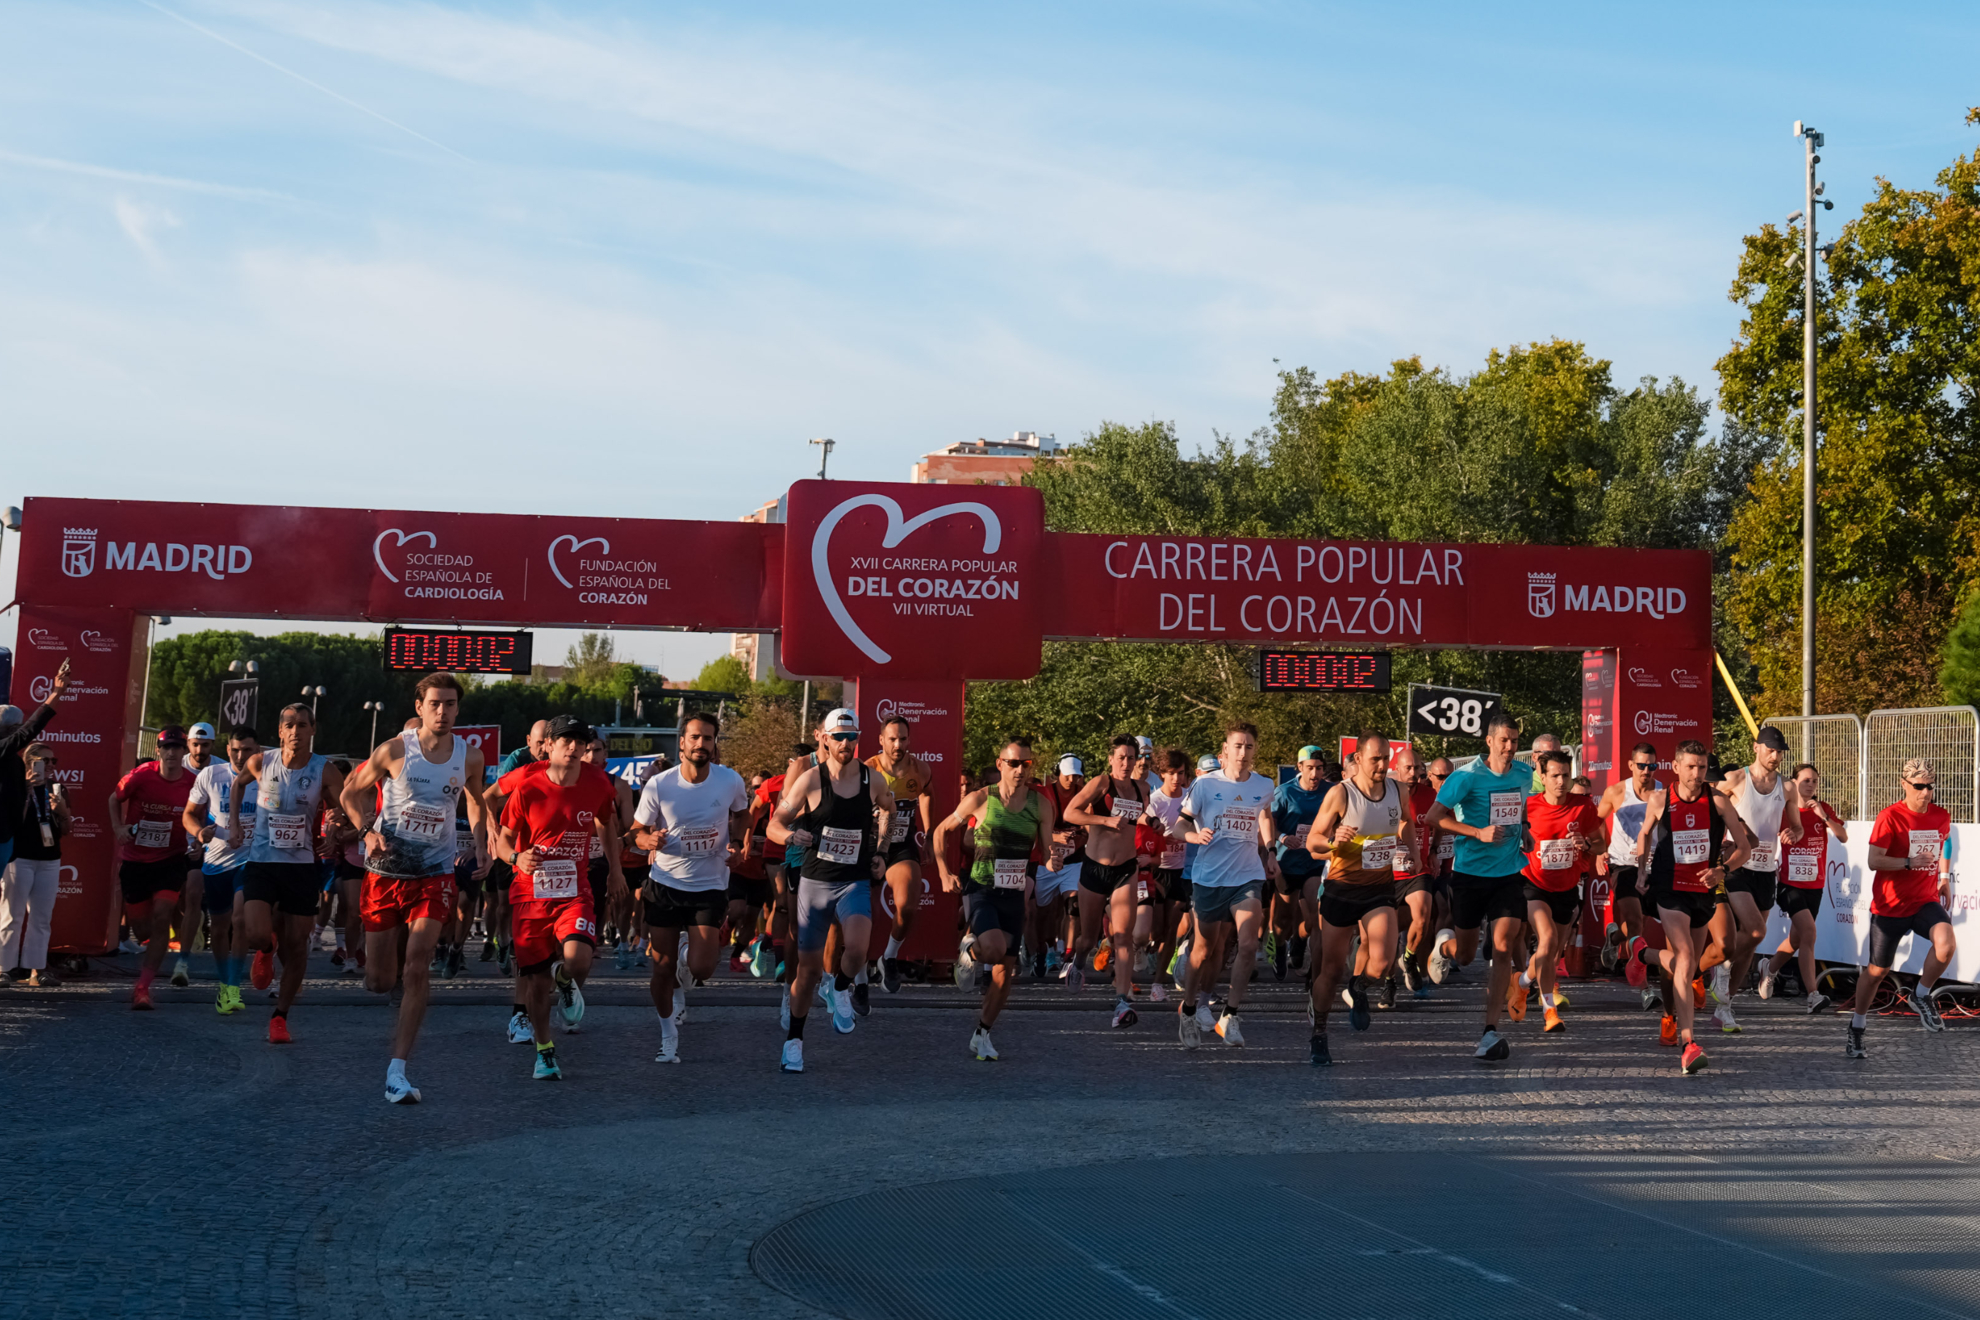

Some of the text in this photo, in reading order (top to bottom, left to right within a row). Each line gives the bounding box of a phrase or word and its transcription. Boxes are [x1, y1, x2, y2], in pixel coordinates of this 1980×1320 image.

[106, 542, 252, 580] MADRID
[406, 553, 474, 566] SOCIEDAD
[580, 558, 656, 573] FUNDACIÓN
[850, 556, 1018, 573] XVII CARRERA POPULAR
[1105, 542, 1464, 586] CARRERA POPULAR
[406, 569, 492, 584] ESPAÑOLA DE
[579, 575, 671, 590] ESPAÑOLA DEL
[404, 586, 504, 600] CARDIOLOGÍA
[848, 576, 1019, 600] DEL CORAZÓN
[578, 590, 648, 605] CORAZÓN
[1565, 584, 1686, 620] MADRID
[893, 602, 974, 616] VII VIRTUAL
[1160, 589, 1422, 635] DEL CORAZÓN
[898, 707, 947, 715] Denervación
[1116, 809, 1140, 820] 2263
[1495, 808, 1518, 817] 1549
[405, 820, 437, 834] 1711
[1227, 820, 1252, 831] 1402
[141, 832, 167, 841] 2187
[275, 830, 298, 840] 962
[686, 839, 715, 851] 1117
[825, 842, 855, 855] 1423
[1678, 844, 1706, 855] 1419
[1916, 845, 1935, 854] 267
[1370, 851, 1390, 861] 238
[1546, 853, 1570, 863] 1872
[1795, 866, 1813, 875] 838
[539, 878, 572, 889] 1127
[1000, 875, 1024, 884] 1704
[1836, 912, 1858, 924] CORAZÓN
[575, 917, 596, 936] 88
